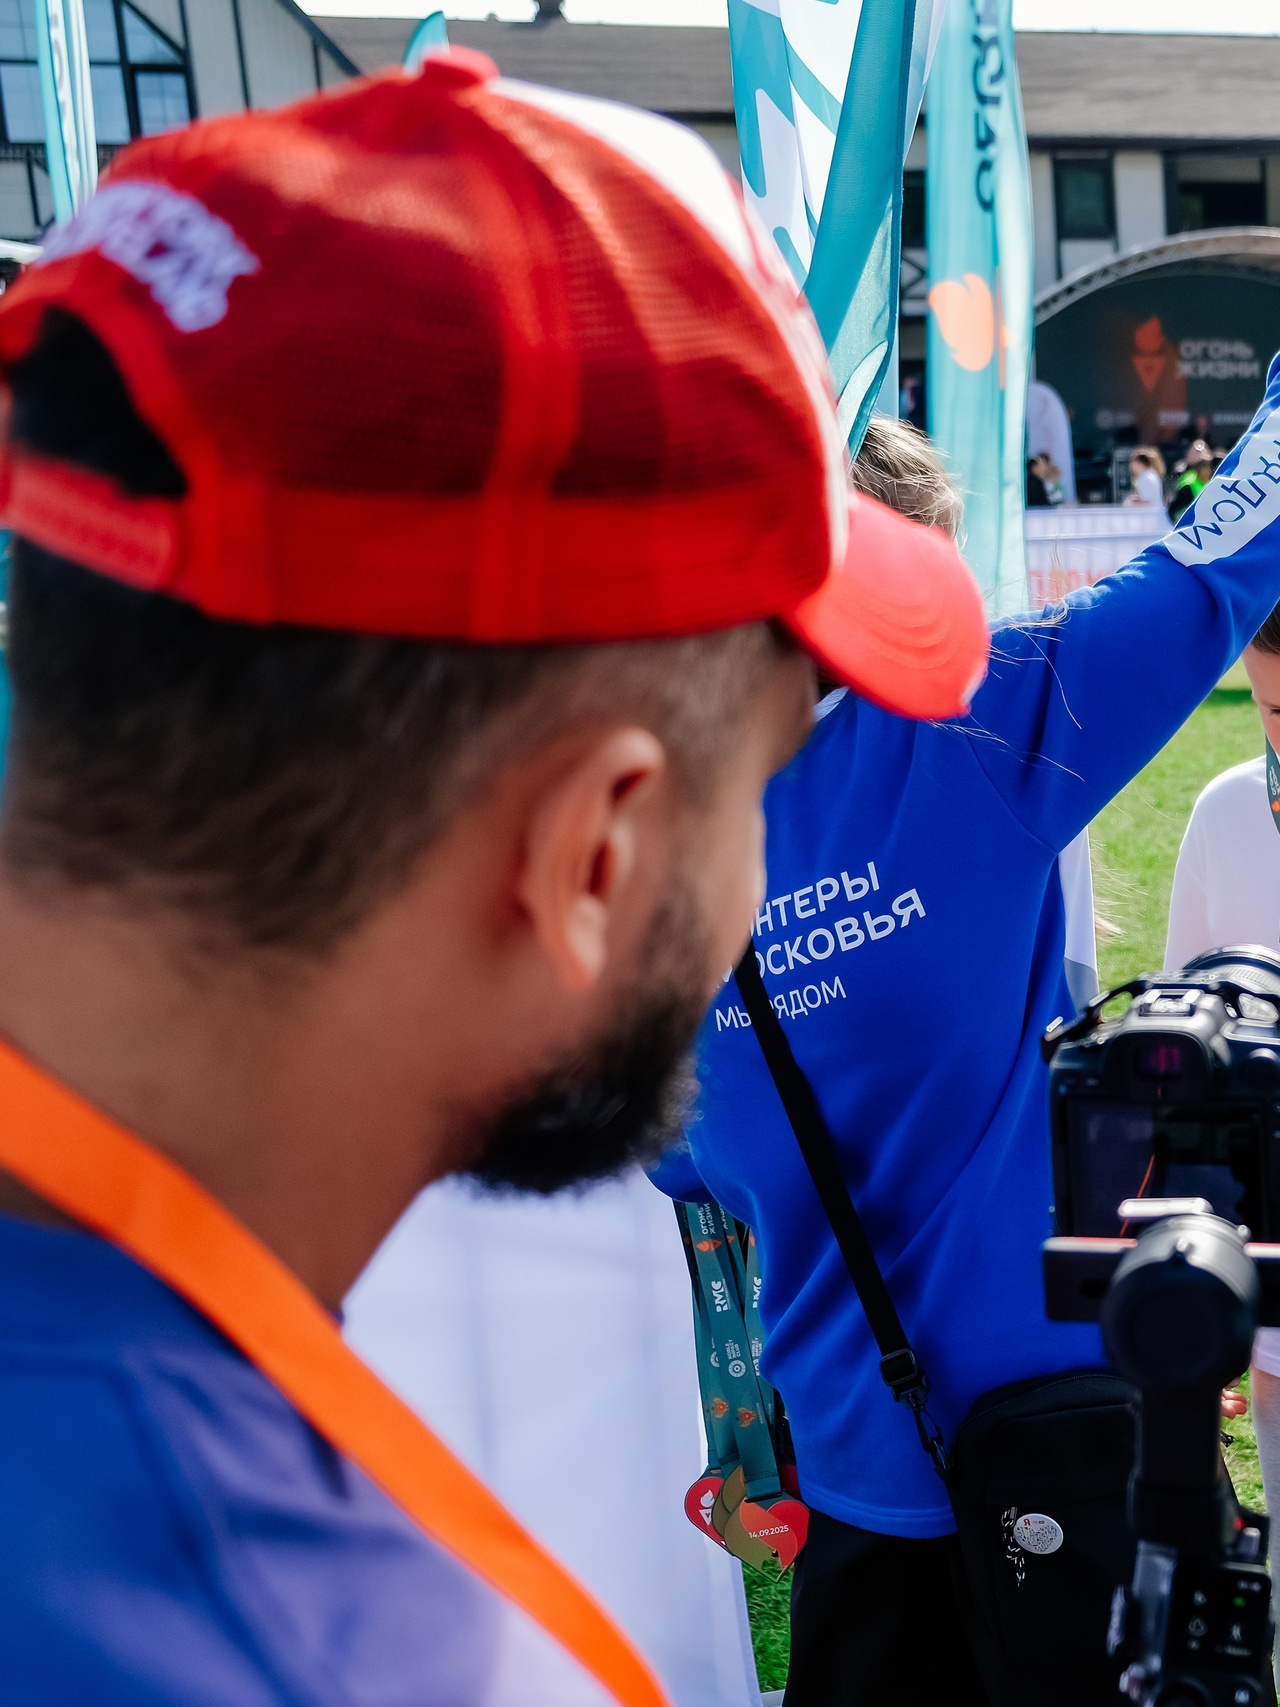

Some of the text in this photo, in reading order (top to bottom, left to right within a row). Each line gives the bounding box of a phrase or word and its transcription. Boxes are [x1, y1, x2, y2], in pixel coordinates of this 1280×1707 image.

[750, 861, 880, 936] НТЕРЫ
[768, 975, 847, 1020] ЯДОМ
[698, 1206, 709, 1235] ОГОНЬ
[748, 1524, 790, 1539] 14.09.2025
